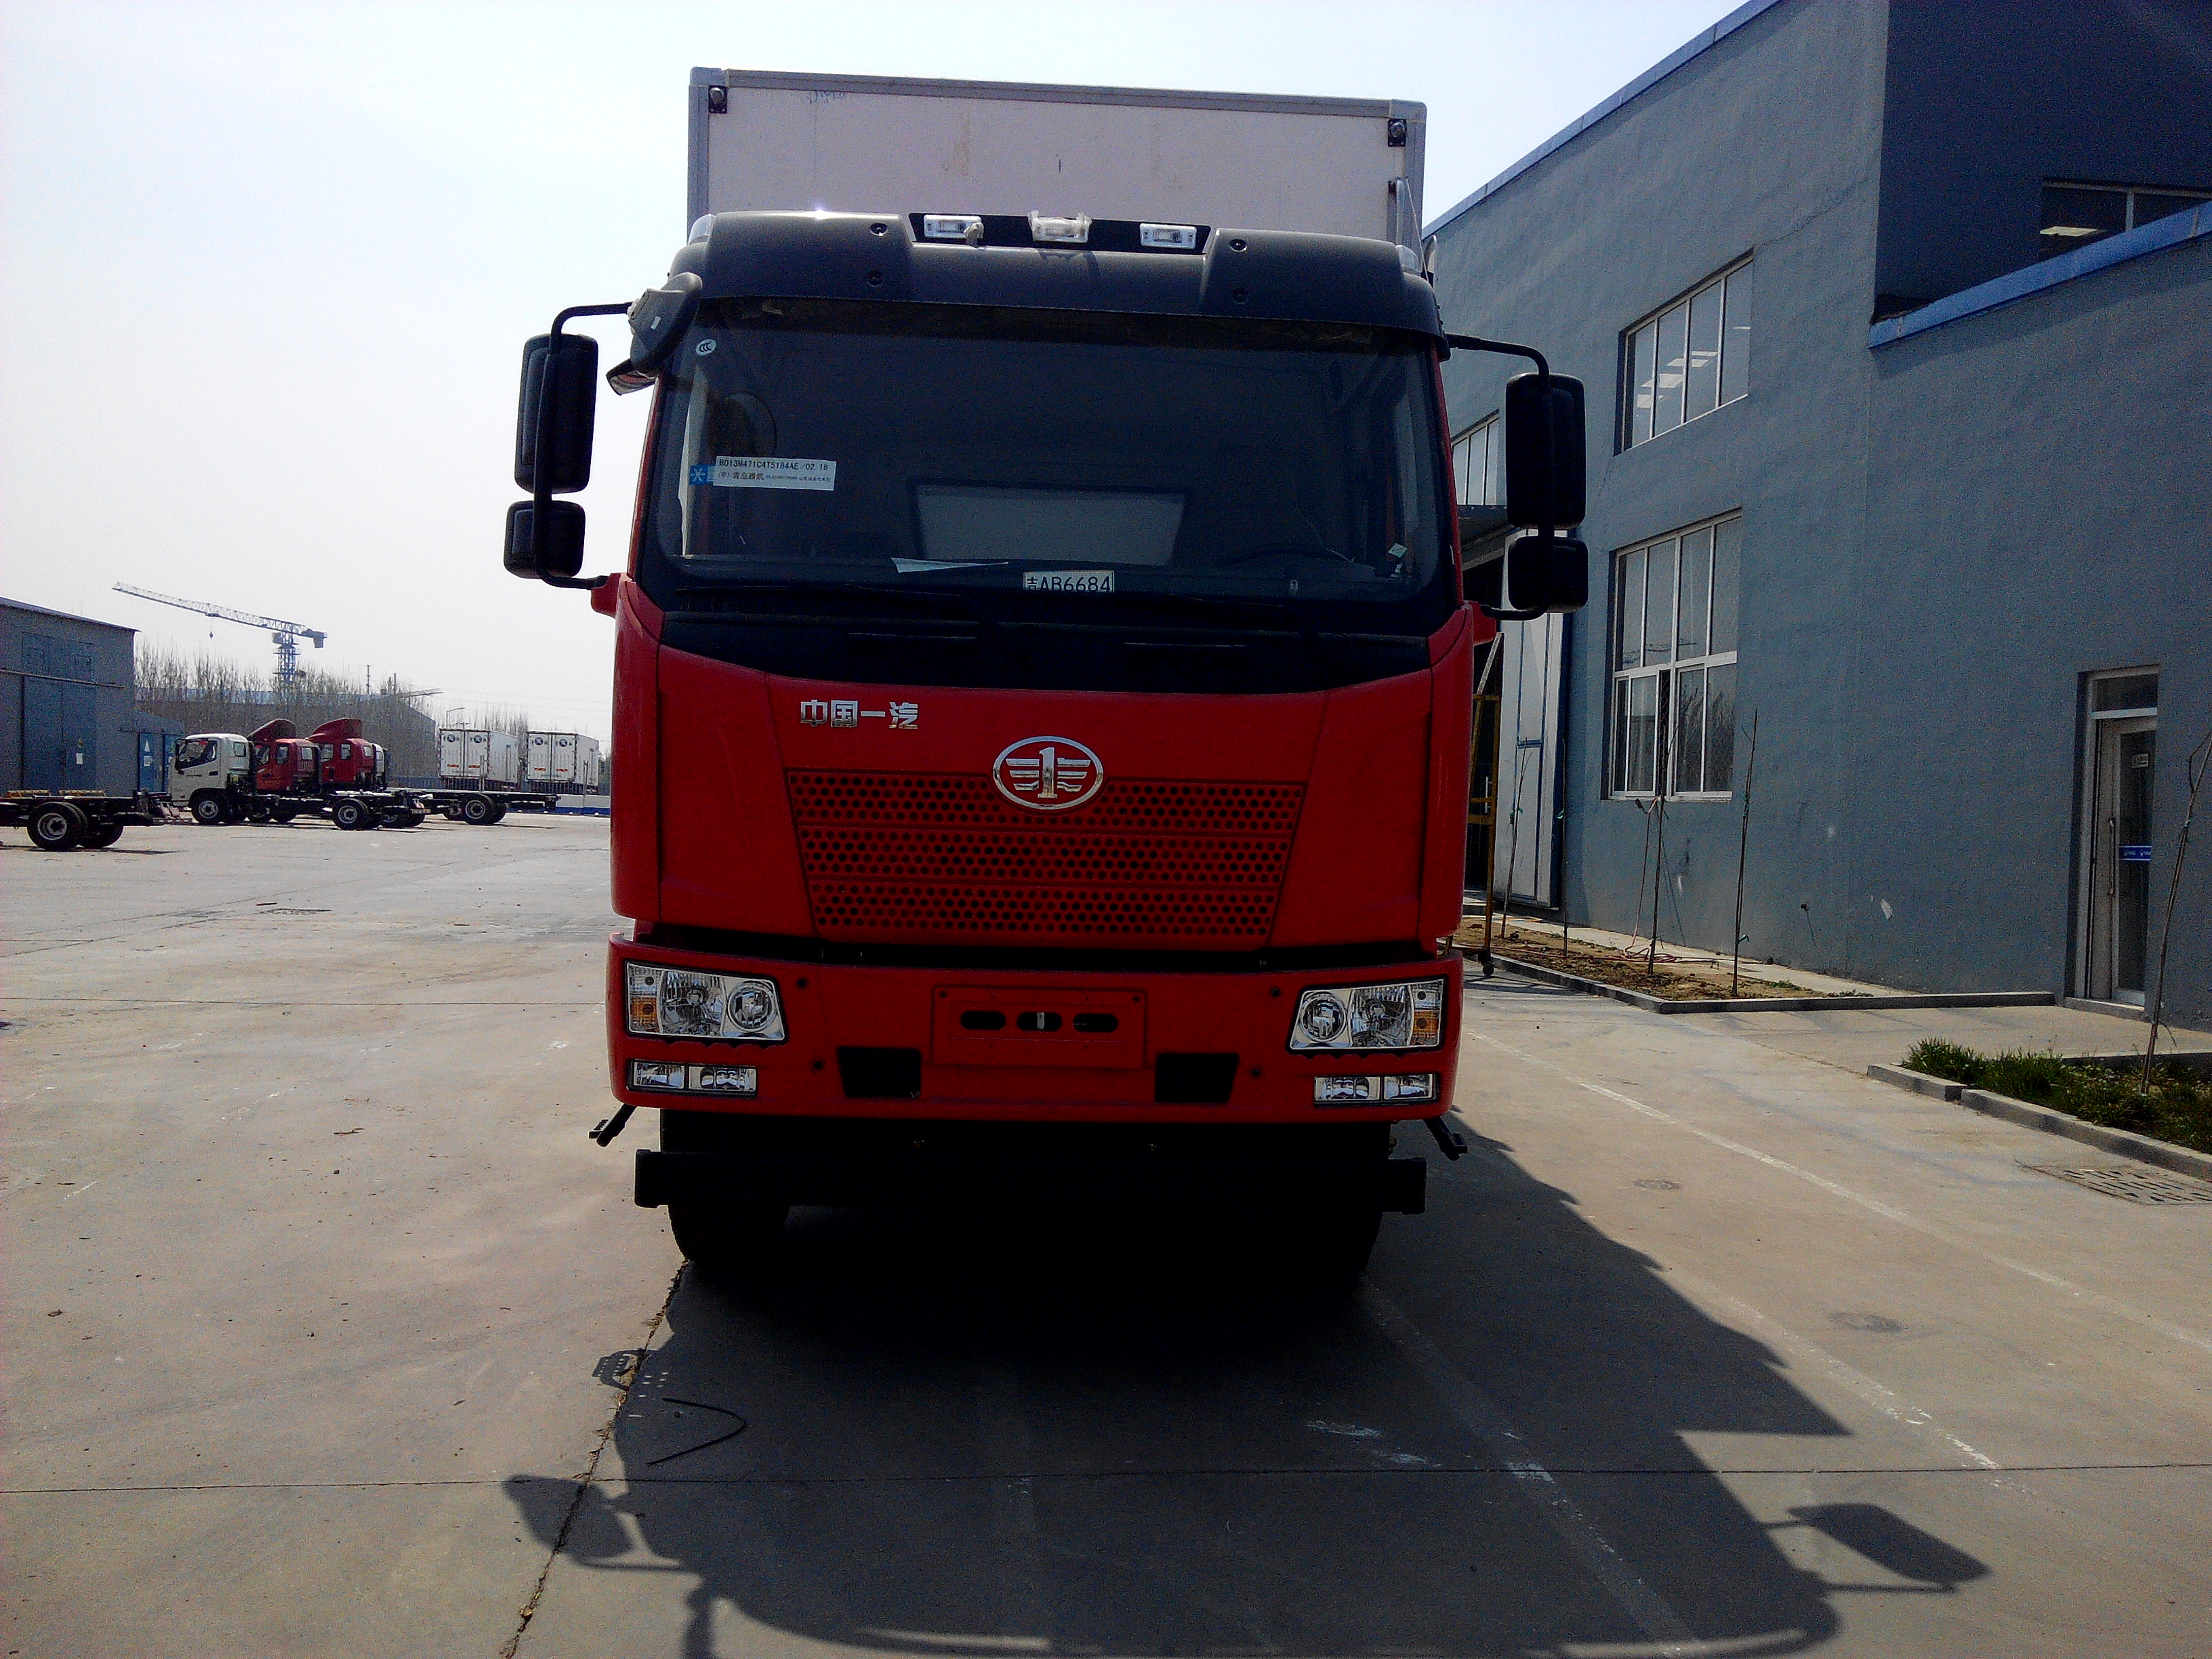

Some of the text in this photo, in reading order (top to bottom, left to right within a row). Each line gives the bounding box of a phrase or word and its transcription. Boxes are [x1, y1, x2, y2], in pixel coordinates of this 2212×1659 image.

[1027, 576, 1111, 592] 吉AB6684
[800, 699, 918, 729] 中国一汽
